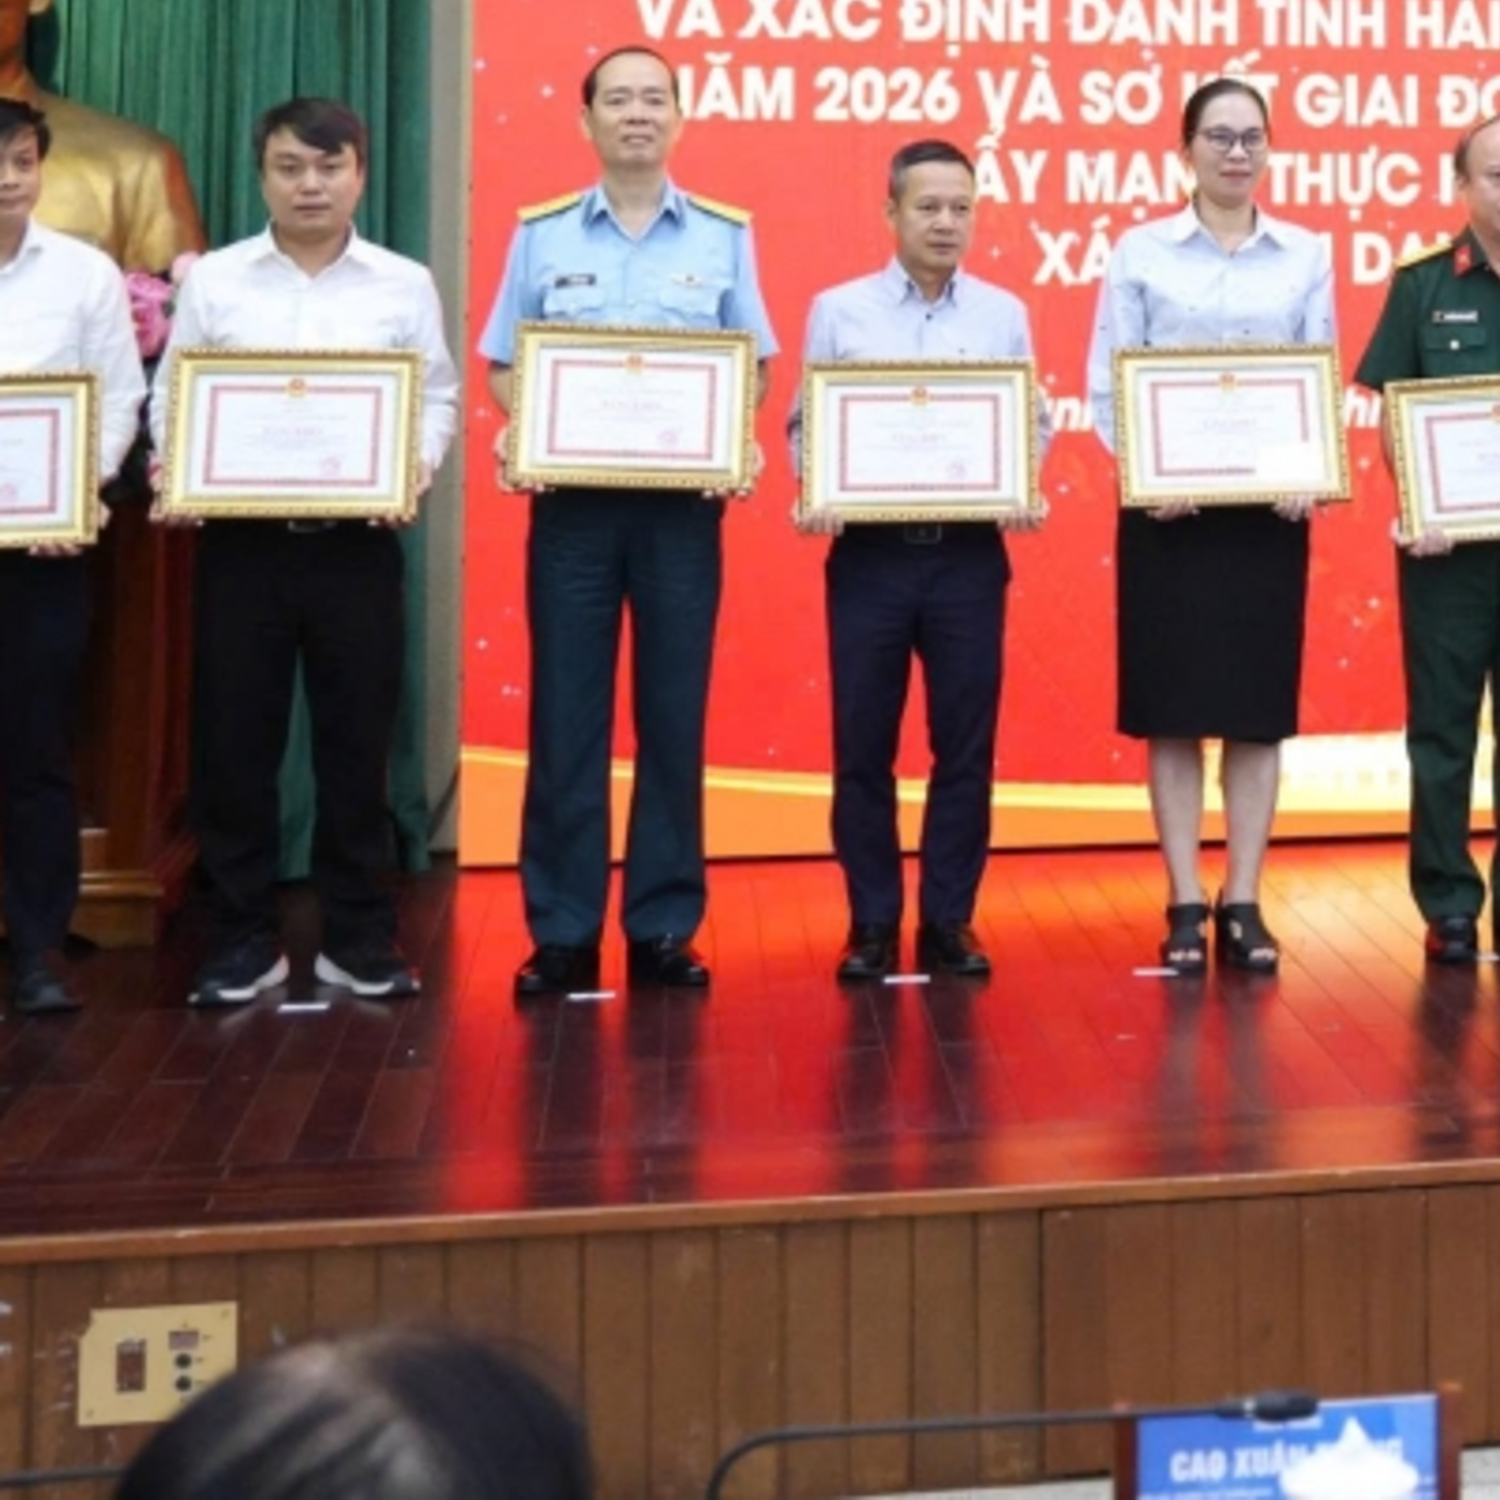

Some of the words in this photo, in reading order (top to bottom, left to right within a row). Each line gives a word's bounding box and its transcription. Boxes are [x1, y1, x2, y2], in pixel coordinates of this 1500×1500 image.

[813, 66, 956, 124] 2026
[974, 54, 1064, 124] VÀ
[1079, 62, 1164, 126] SƠ
[1292, 72, 1420, 129] GIAI
[1066, 149, 1198, 221] MẠN
[1266, 144, 1422, 222] THỰC
[1031, 214, 1115, 286] XÁ
